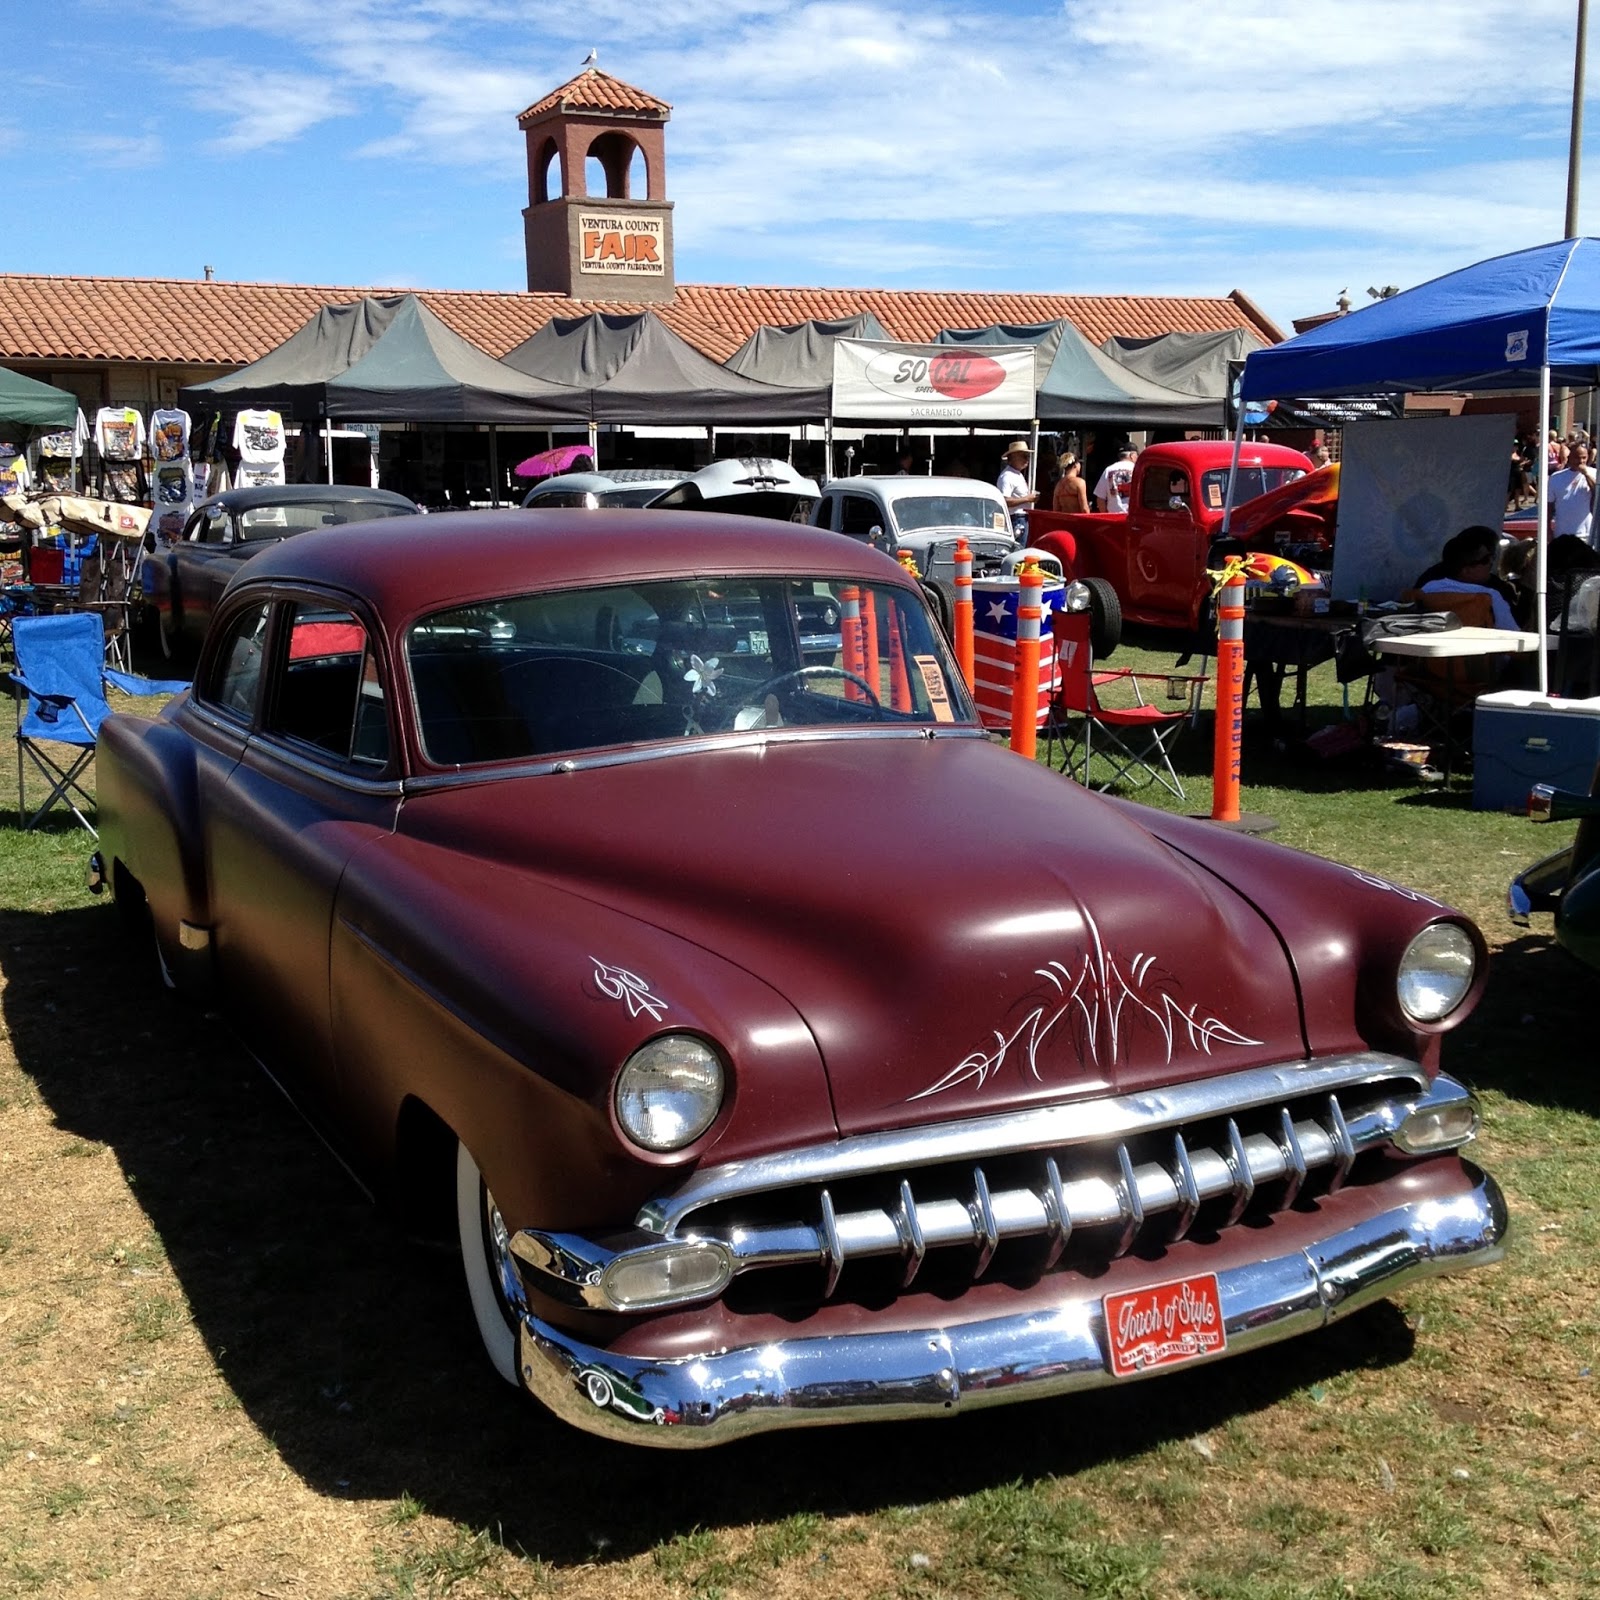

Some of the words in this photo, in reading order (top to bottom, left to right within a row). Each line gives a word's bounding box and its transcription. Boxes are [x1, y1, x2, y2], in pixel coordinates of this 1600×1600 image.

[581, 218, 623, 230] VENTURA
[625, 220, 660, 232] COUNTY
[584, 231, 660, 262] FAIR
[581, 261, 605, 270] VENTURA
[606, 262, 625, 271] COUNTY
[627, 263, 663, 272] FAIRGROUNDS
[893, 359, 972, 384] SO-CAL
[910, 407, 963, 417] SACRAMENTO
[1117, 1297, 1162, 1348] Touch
[1164, 1295, 1178, 1339] of
[1178, 1282, 1216, 1331] Style
